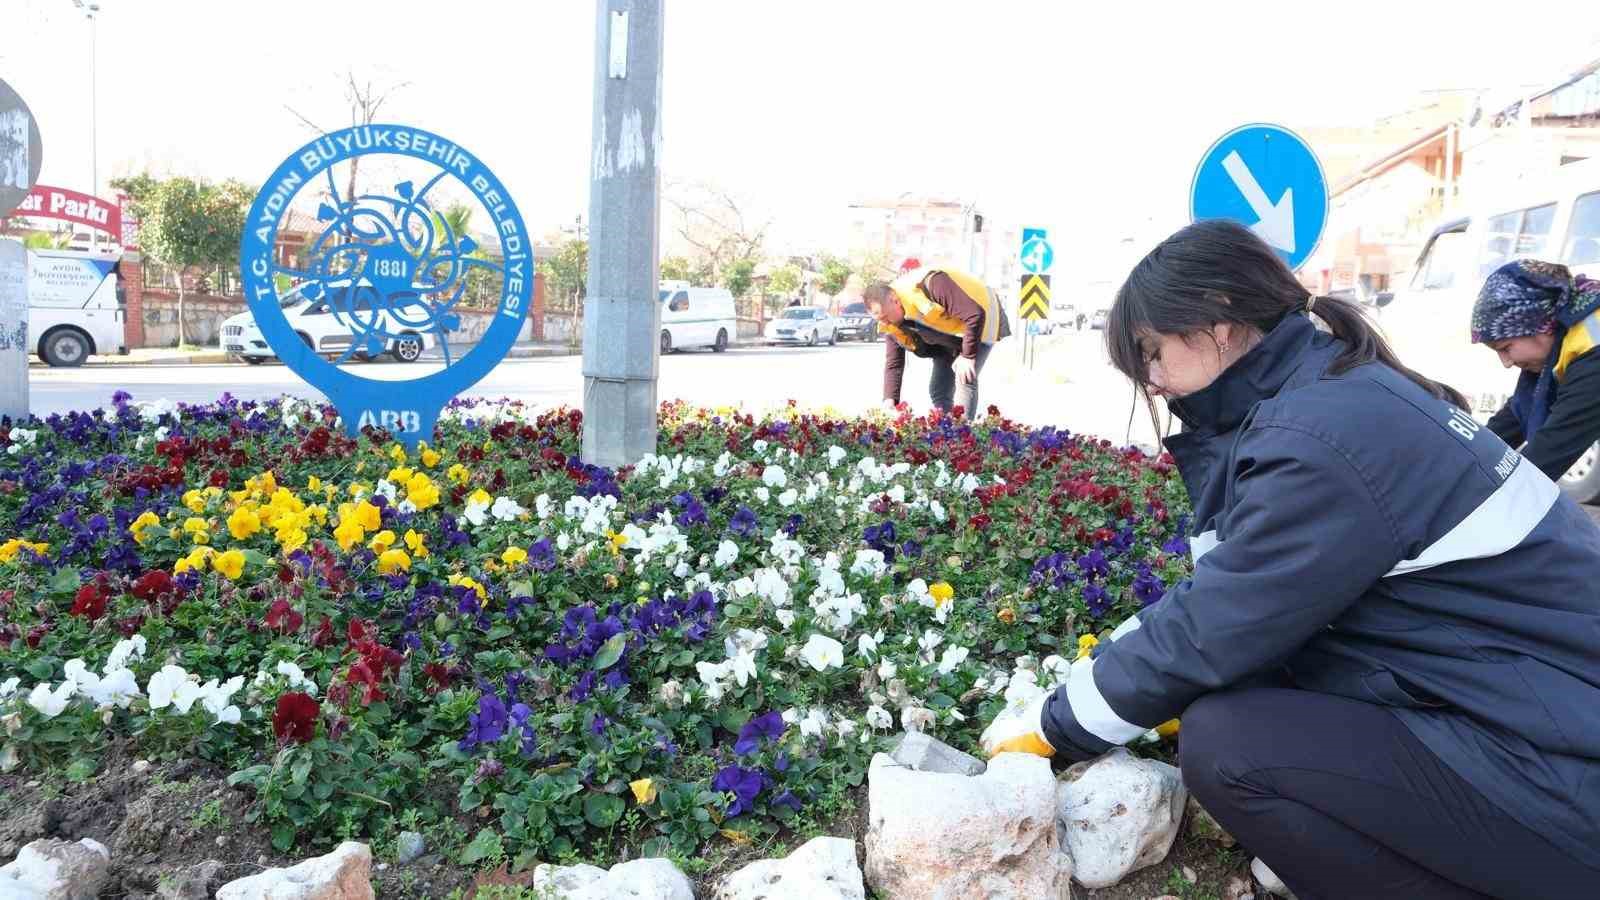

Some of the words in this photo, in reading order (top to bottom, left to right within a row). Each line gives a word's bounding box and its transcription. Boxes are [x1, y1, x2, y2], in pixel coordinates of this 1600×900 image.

[17, 193, 43, 211] ar
[255, 171, 302, 245] AYDIN
[300, 126, 471, 176] BÜYÜKŞEHİR
[470, 173, 527, 320] BELEDİYESİ
[374, 259, 407, 277] 1881
[356, 409, 421, 433] ABB
